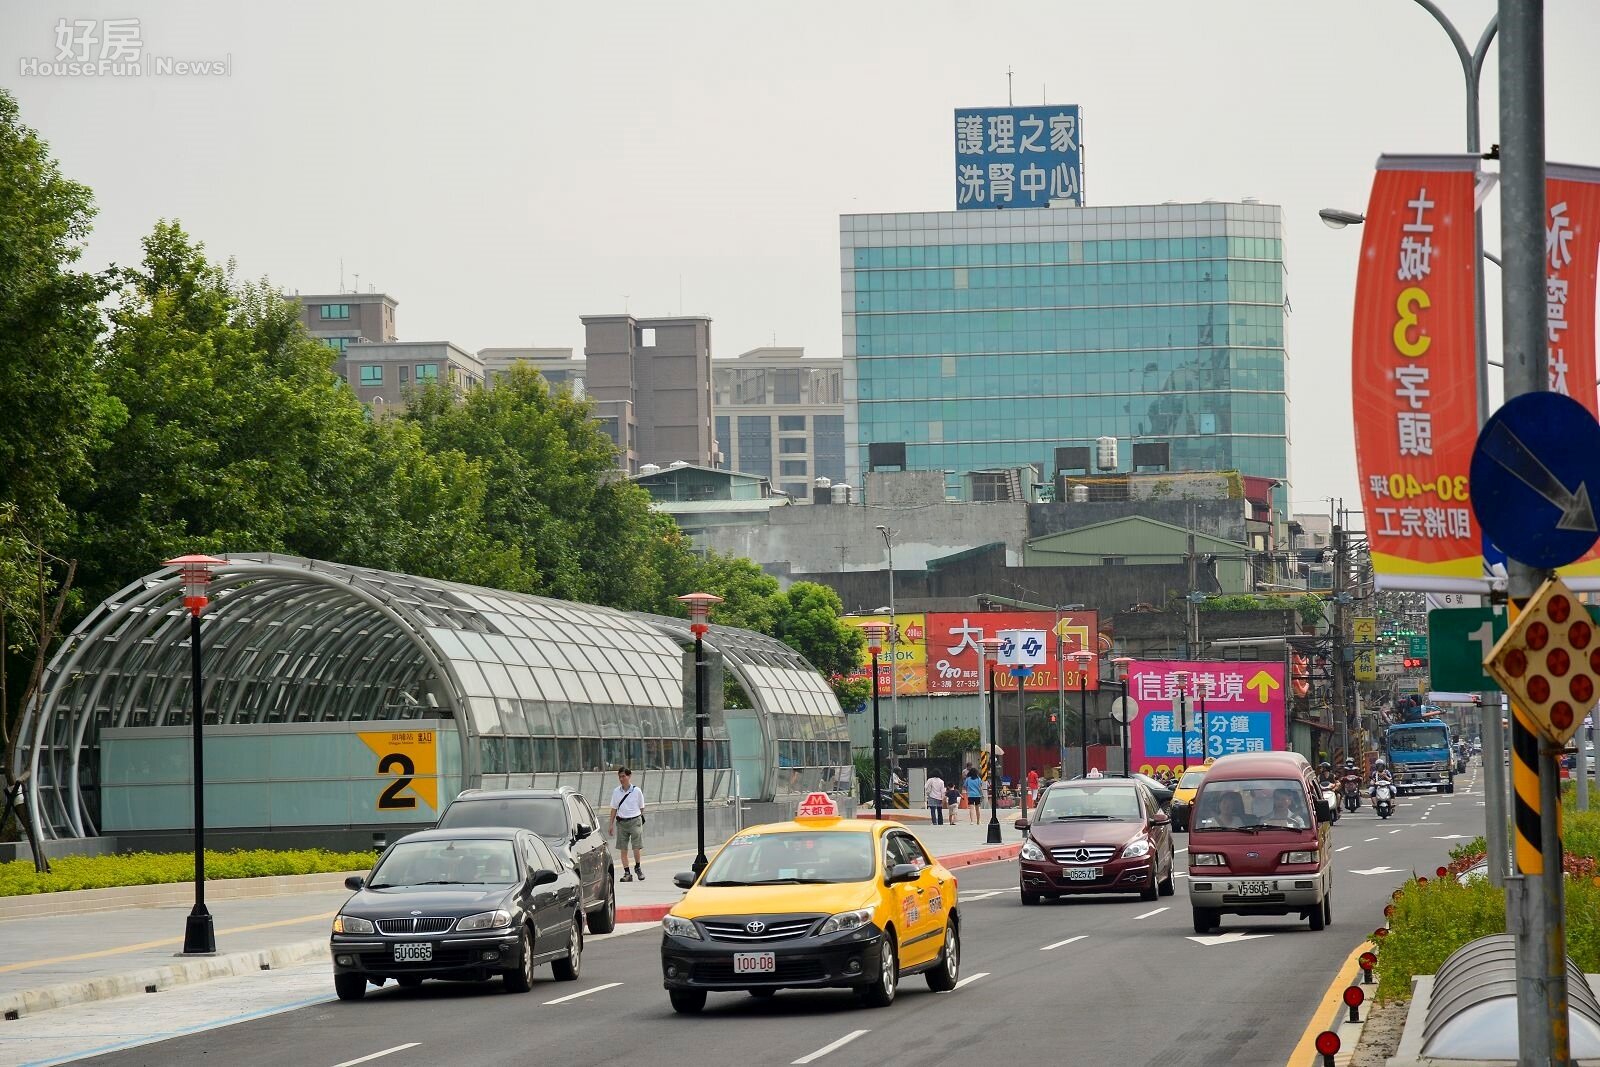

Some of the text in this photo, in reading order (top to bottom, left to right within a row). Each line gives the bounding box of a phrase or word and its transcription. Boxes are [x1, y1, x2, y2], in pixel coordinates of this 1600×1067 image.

[957, 112, 1077, 155] 護理之家
[958, 162, 1079, 204] 洗腎中心
[1151, 712, 1250, 733] 捷5分鐘
[1166, 734, 1265, 756] 最後3字頭
[378, 753, 416, 808] 2
[800, 806, 834, 816] 大都會
[811, 796, 824, 805] M
[395, 946, 432, 960] 5U-0665
[737, 957, 774, 970] 100-D8
